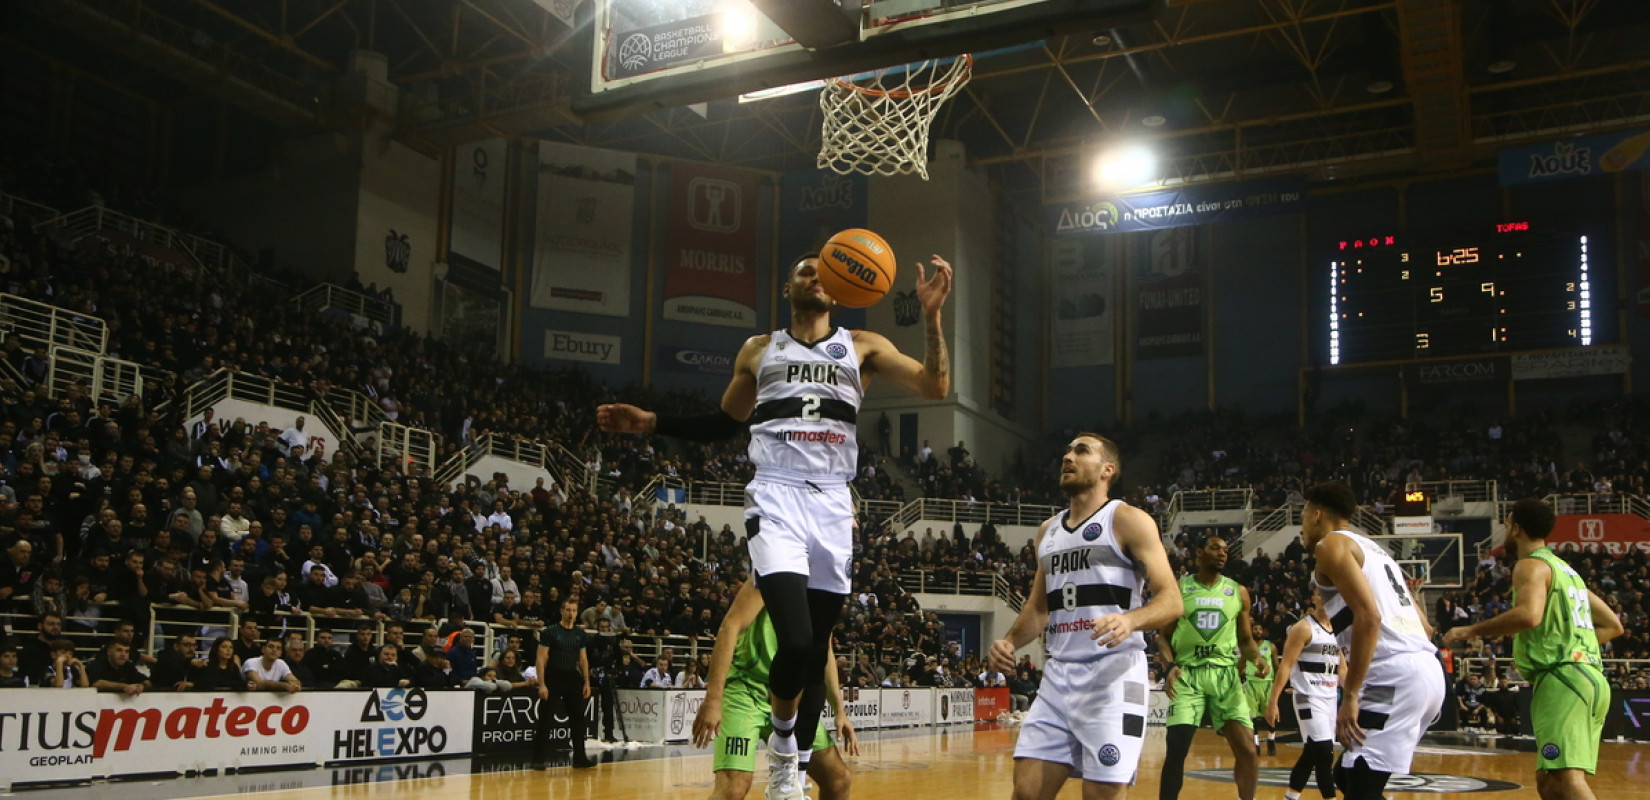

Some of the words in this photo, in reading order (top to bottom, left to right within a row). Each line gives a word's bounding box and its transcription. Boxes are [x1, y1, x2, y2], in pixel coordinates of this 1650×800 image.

[653, 32, 719, 51] CHAMPIONS
[654, 24, 712, 42] BASKETBALL
[653, 47, 689, 61] LEAGUE
[1056, 205, 1108, 230] Διός
[1133, 203, 1193, 220] ΠΡΟΣΤΑΣΙΑ
[1496, 222, 1529, 232] TOFAS
[680, 248, 745, 275] MORRIS
[832, 248, 877, 285] Wilson
[1430, 286, 1443, 303] 5
[1481, 282, 1495, 297] 9
[552, 334, 614, 361] Ebury
[786, 363, 840, 386] PAOK
[1420, 362, 1494, 379] FARCOM
[801, 393, 821, 422] 2
[1051, 549, 1091, 575] PAOK
[1062, 582, 1077, 611] 8
[1196, 611, 1220, 629] 50
[92, 698, 310, 759] mateco
[240, 746, 278, 756] AIMING
[282, 745, 305, 754] HIGH
[333, 725, 447, 759] HELEXPO
[725, 736, 751, 757] FIAT
[29, 754, 94, 767] GEOPLAN
